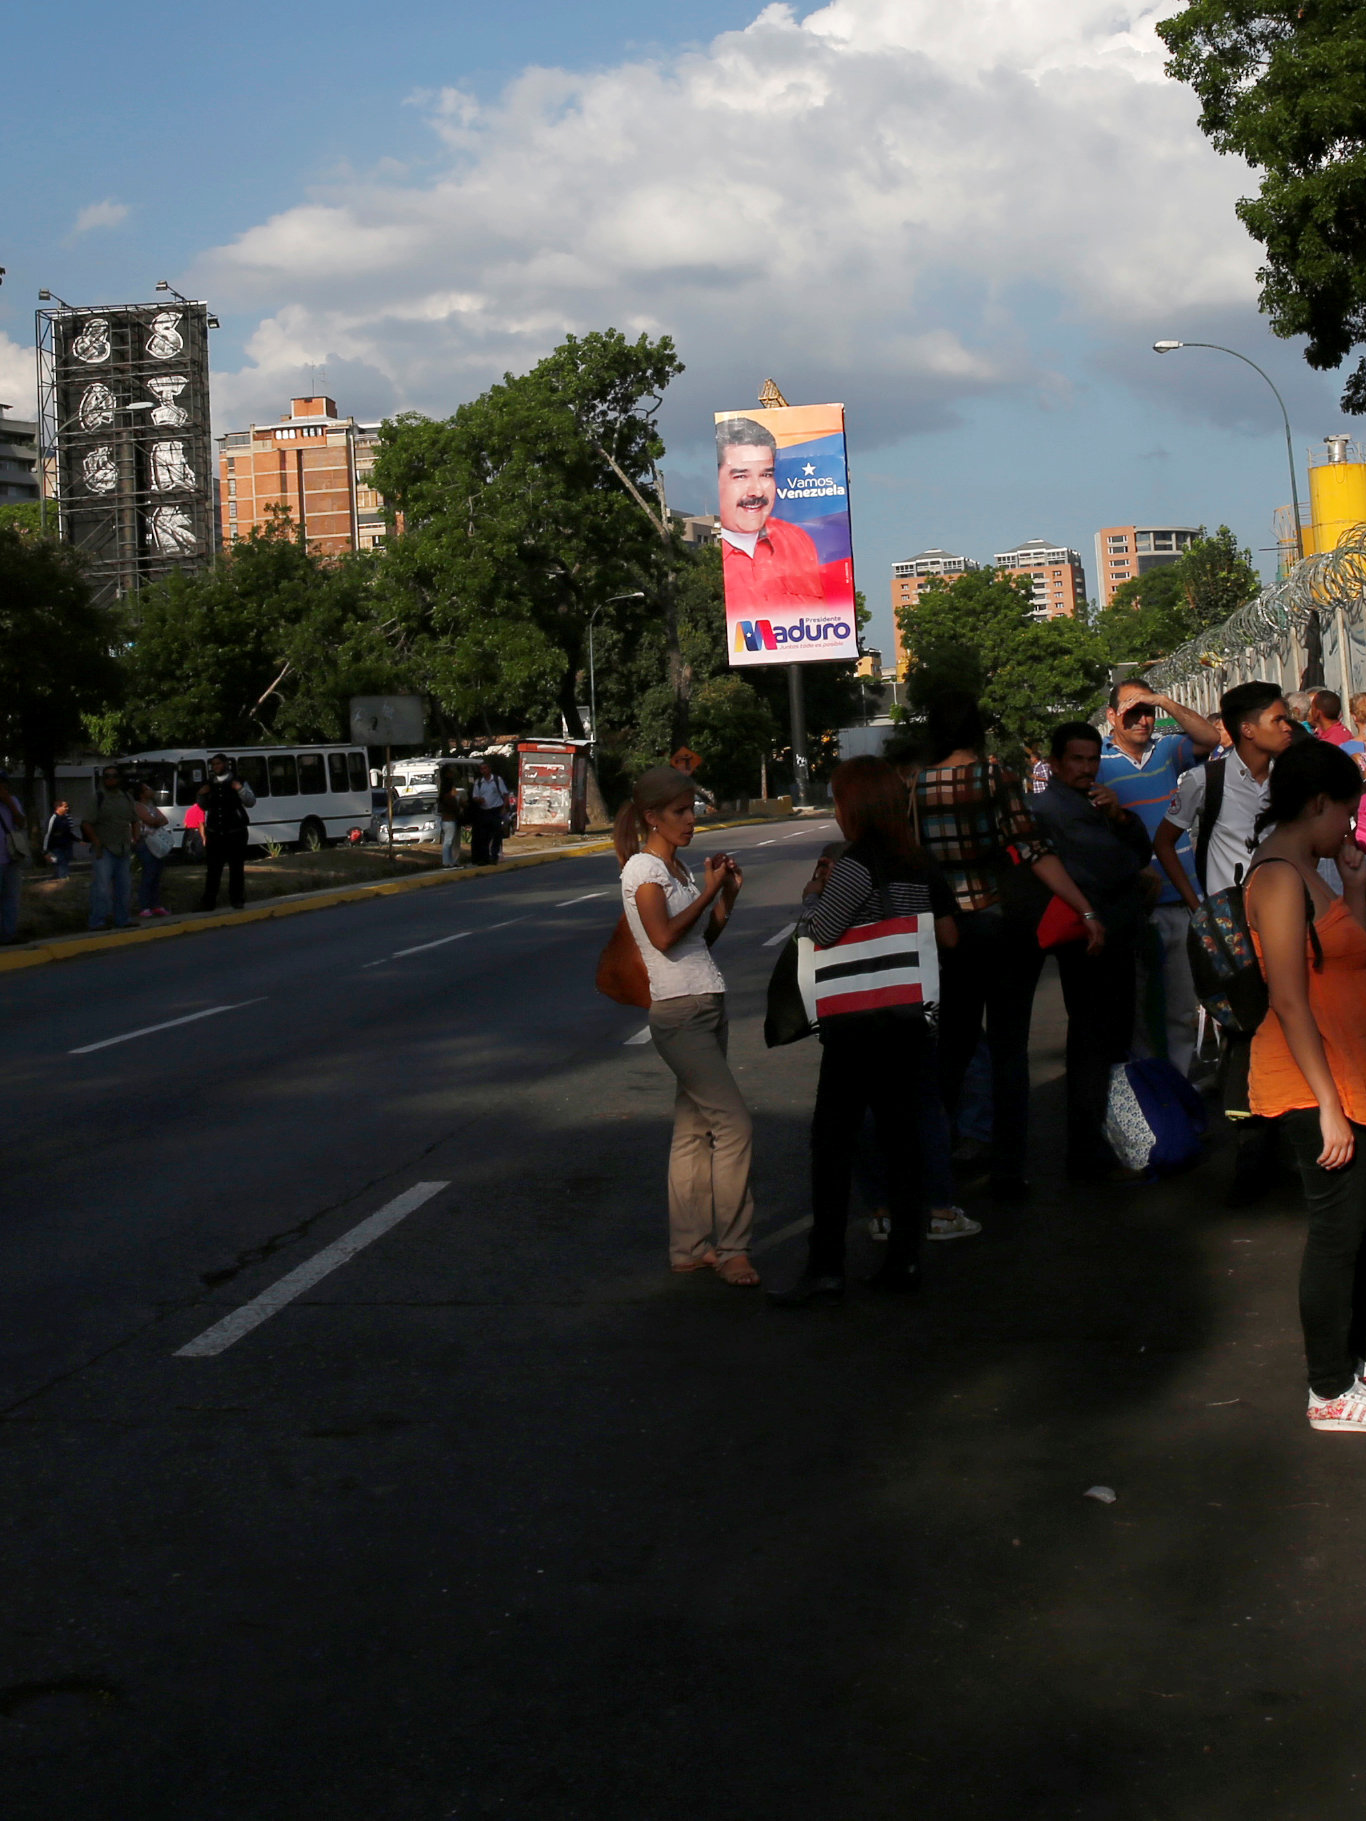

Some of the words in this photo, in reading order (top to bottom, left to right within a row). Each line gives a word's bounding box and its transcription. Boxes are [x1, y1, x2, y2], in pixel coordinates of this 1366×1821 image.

[787, 477, 833, 489] Vamos
[776, 484, 845, 499] Venezuela
[734, 618, 851, 652] Maduro
